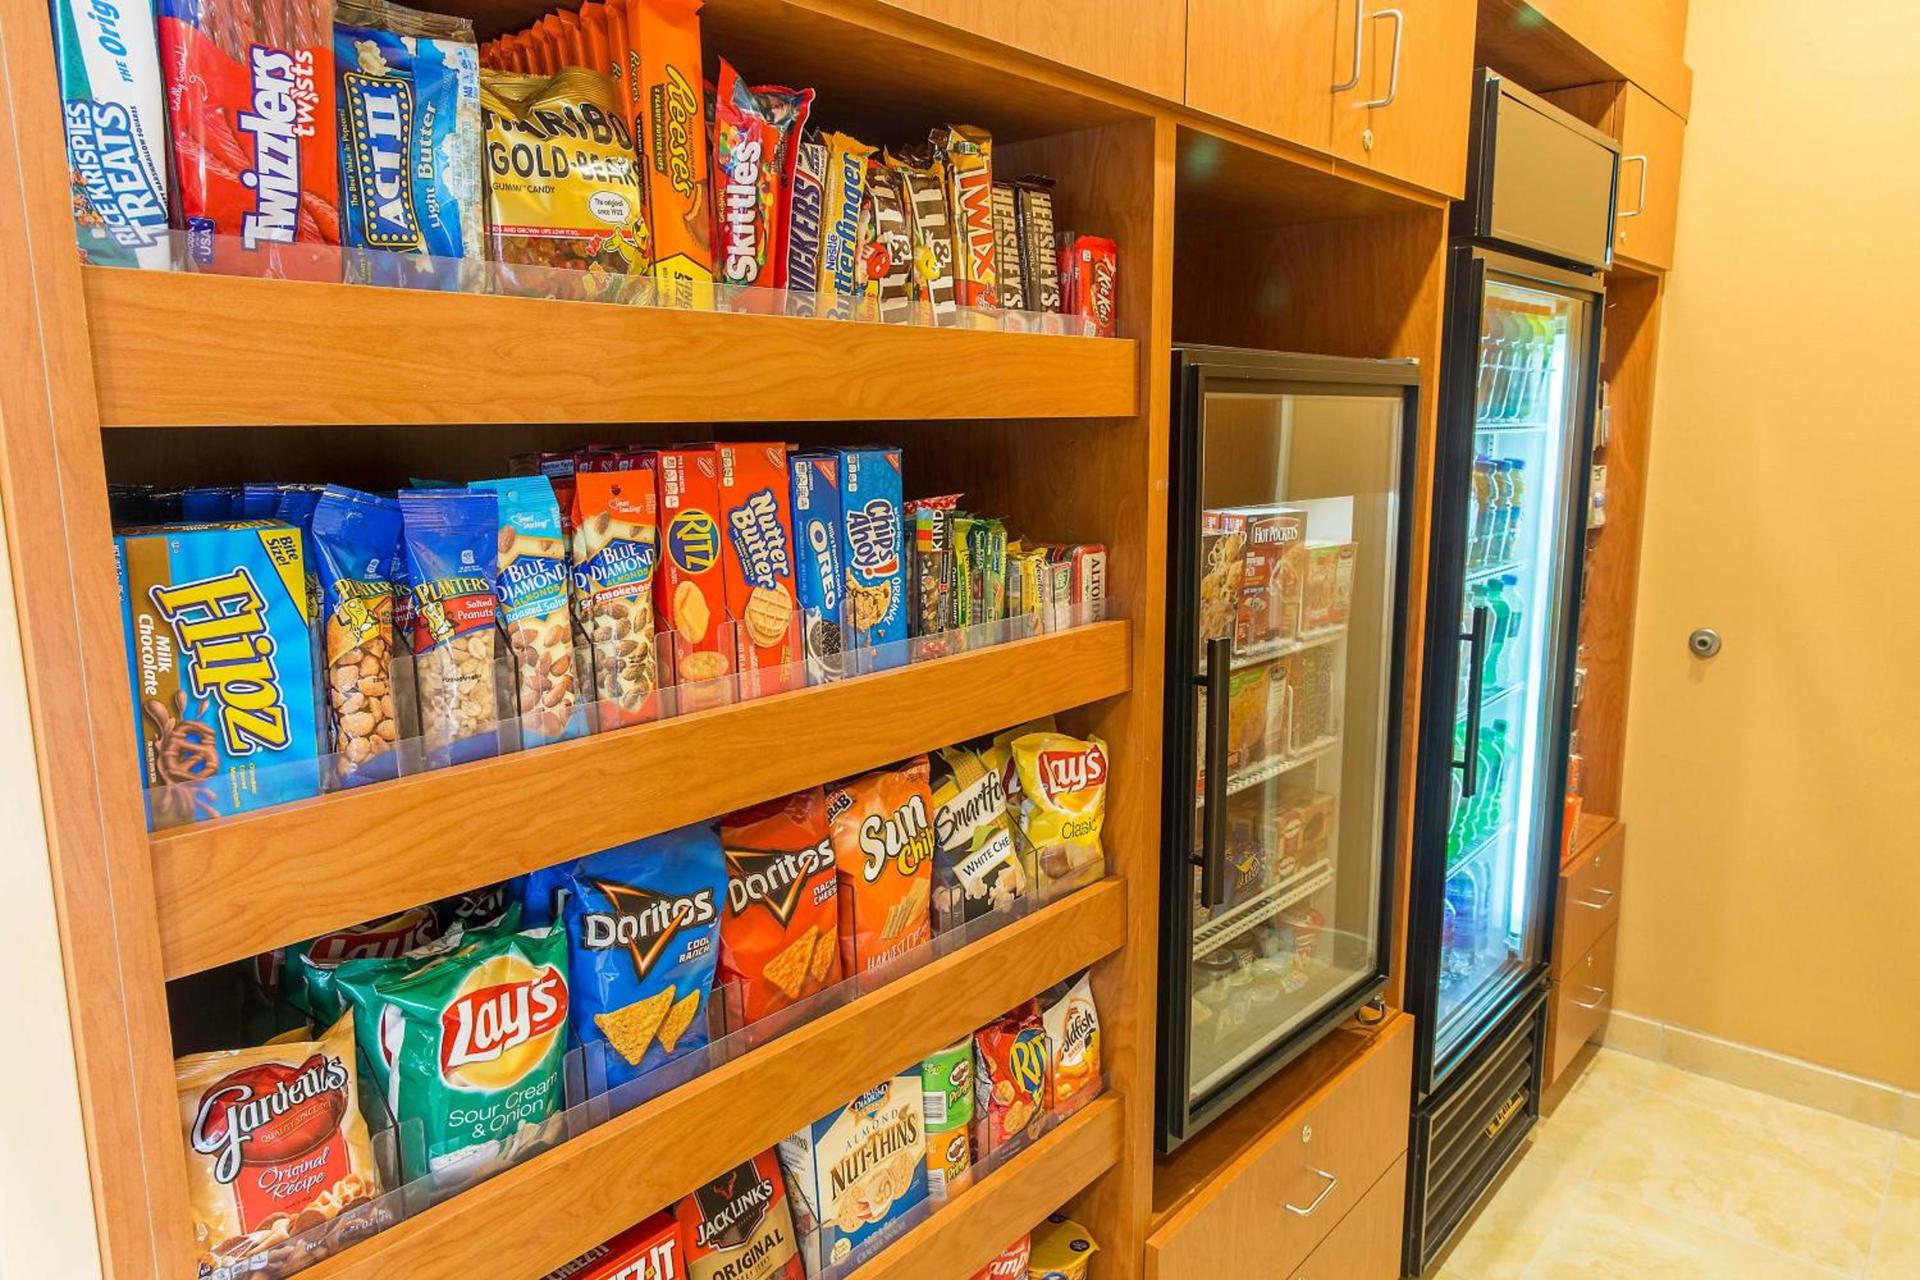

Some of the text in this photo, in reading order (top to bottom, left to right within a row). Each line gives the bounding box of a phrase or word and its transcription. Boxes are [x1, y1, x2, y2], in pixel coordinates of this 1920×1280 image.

[122, 60, 133, 82] THE
[292, 50, 320, 138] twists
[654, 94, 662, 123] PEANUT
[243, 46, 299, 250] Twizzlers
[666, 64, 698, 199] Reese's
[67, 102, 141, 245] RICE KRISPIES
[93, 104, 169, 245] TREATS
[363, 92, 409, 230] ACT II
[416, 100, 442, 229] Light Butter
[526, 185, 556, 194] CANDY
[726, 140, 762, 281] Skittles
[957, 156, 997, 282] TWIX
[200, 229, 212, 255] USA
[1027, 232, 1037, 281] CHOCOLATE
[1029, 191, 1061, 308] HERSHEY'S
[266, 538, 289, 567] Size!
[279, 536, 299, 561] Bite
[676, 514, 717, 569] RITZ
[730, 506, 775, 590] Butter
[751, 490, 789, 576] Nutter
[864, 500, 896, 564] Chips
[931, 509, 945, 553] KIND
[1254, 526, 1270, 544] HOT
[508, 558, 548, 583] BLUE
[590, 548, 655, 581] DIAMOND
[603, 543, 639, 565] BLUE
[808, 519, 836, 610] OREO
[832, 544, 841, 573] Favorite
[414, 576, 490, 605] PLANTERS
[465, 599, 494, 609] Salted
[496, 563, 567, 603] DIAMOND
[835, 573, 843, 599] Cookie
[884, 576, 902, 627] ORIGINAL
[457, 610, 494, 621] Peanuts
[138, 613, 158, 696] Chocolate
[151, 566, 290, 755] Flipz
[156, 634, 172, 674] Milk
[1042, 751, 1102, 795] Lay's
[859, 794, 928, 882] Sun
[1061, 817, 1098, 840] Classic
[727, 839, 836, 913] Doritos
[963, 847, 993, 877] WHITE
[585, 890, 716, 949] Doritos
[679, 945, 711, 964] RANCH
[687, 935, 710, 951] COOL
[866, 939, 907, 976] HARVEST
[447, 976, 562, 1068] Lay's
[448, 1071, 559, 1128] Sour Cream
[471, 1100, 544, 1139] & Onion
[260, 1120, 294, 1144] QUALITY
[844, 1108, 899, 1150] ALMOND
[257, 1146, 331, 1189] Original
[829, 1113, 919, 1202] NUT-THINS
[269, 1170, 325, 1201] Recipe
[696, 1179, 774, 1247] JACK LINK'S
[712, 1228, 785, 1280] ORIGINAL
